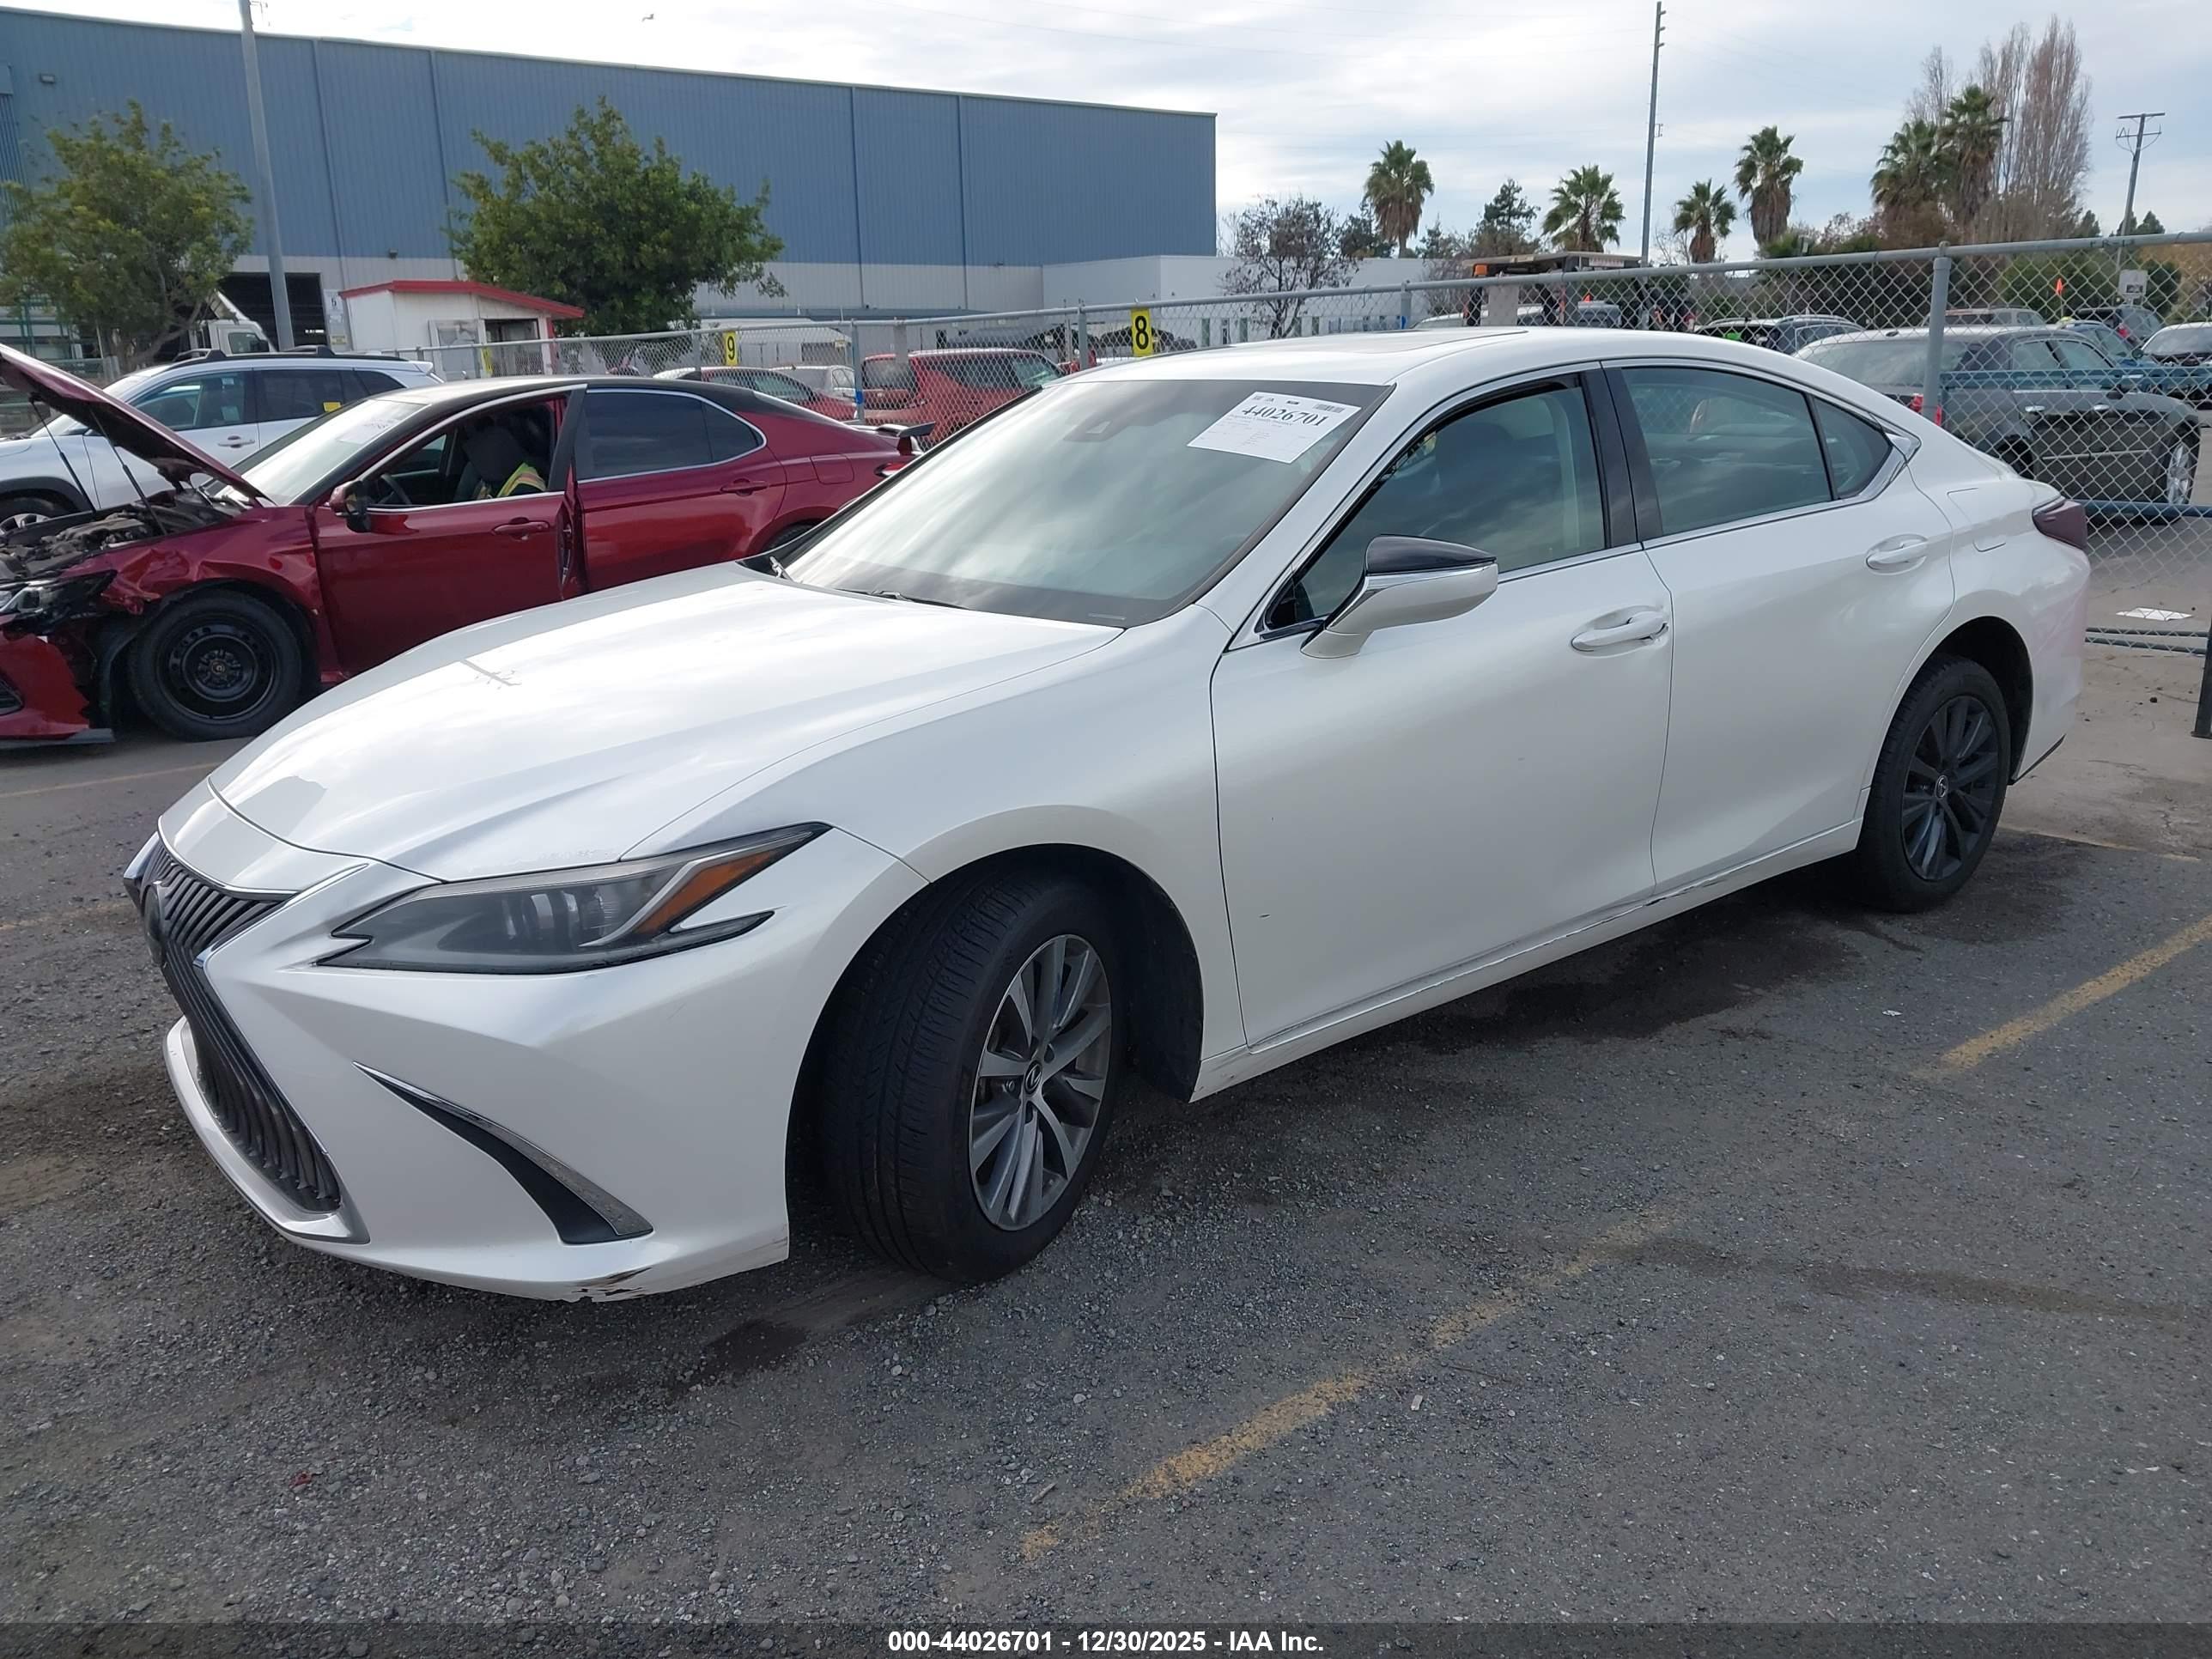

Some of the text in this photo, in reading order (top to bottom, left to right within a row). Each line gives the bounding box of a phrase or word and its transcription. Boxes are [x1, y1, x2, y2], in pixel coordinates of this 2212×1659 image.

[1135, 315, 1149, 349] 8
[727, 336, 735, 361] 9
[1243, 405, 1328, 426] 44026701
